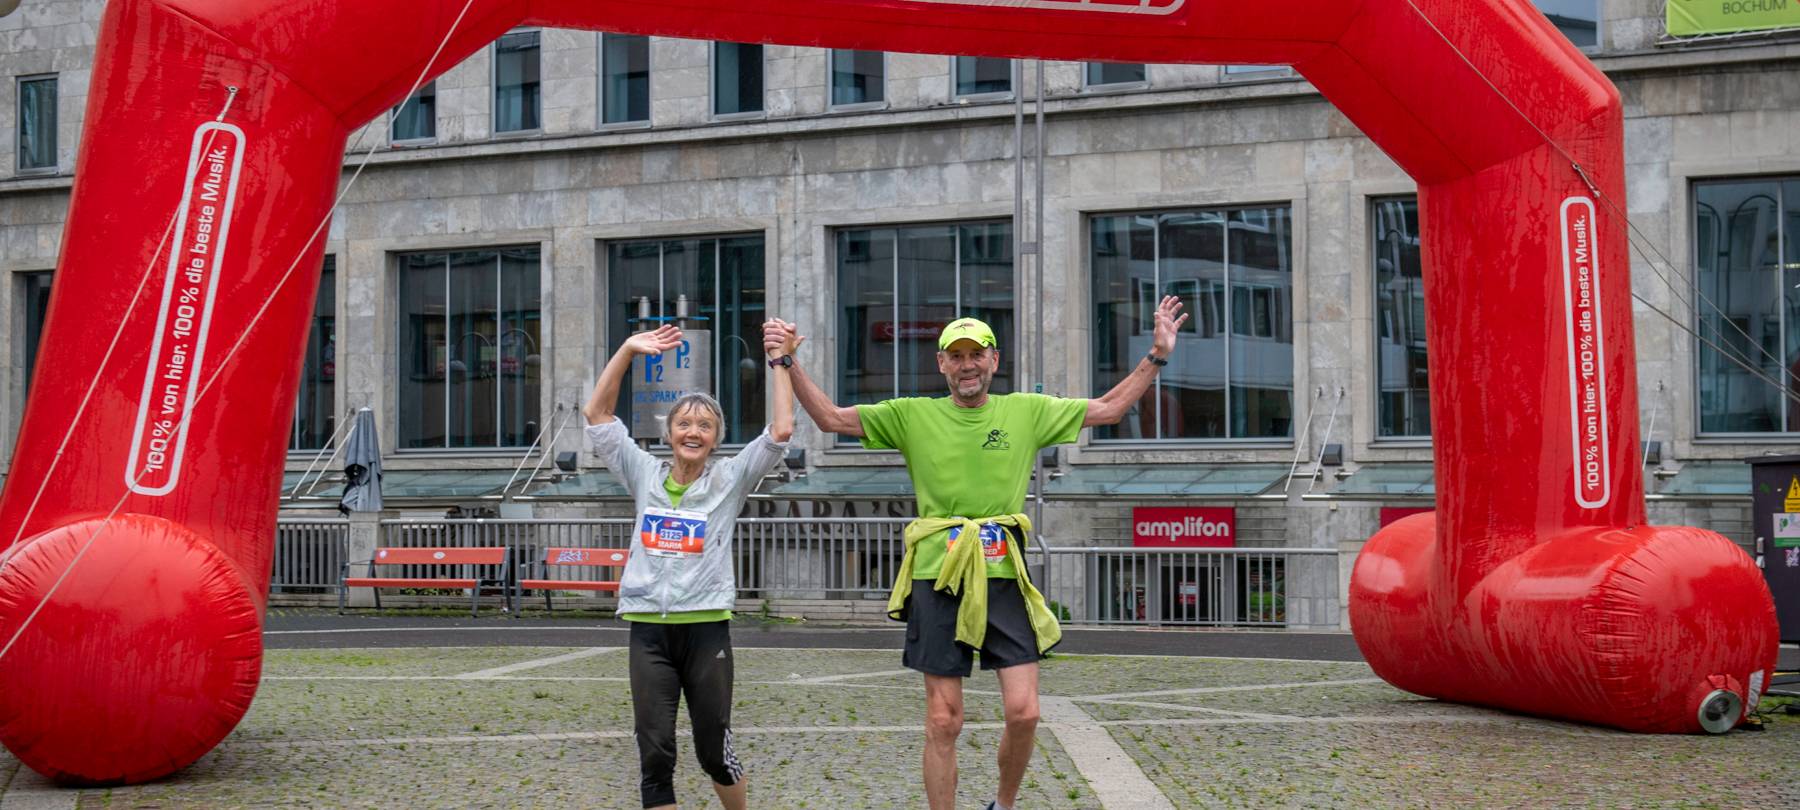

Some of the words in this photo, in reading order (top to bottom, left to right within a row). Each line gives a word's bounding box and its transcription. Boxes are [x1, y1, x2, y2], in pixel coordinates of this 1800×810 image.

[1722, 0, 1787, 15] BOCHUM
[200, 145, 228, 202] Musik.
[190, 205, 215, 254] beste
[1573, 215, 1588, 263] Musik.
[185, 257, 205, 283] die
[1578, 266, 1591, 308] beste
[172, 288, 199, 340] 100%
[1579, 311, 1592, 332] die
[164, 344, 188, 380] hier.
[1580, 334, 1594, 380] 100%
[161, 384, 179, 415] von
[1583, 382, 1597, 413] hier.
[1587, 416, 1598, 442] von
[146, 421, 172, 473] 100%
[1586, 445, 1600, 490] 100%
[658, 540, 682, 550] MARIA
[661, 530, 682, 540] 3125
[1136, 516, 1229, 542] amplifon
